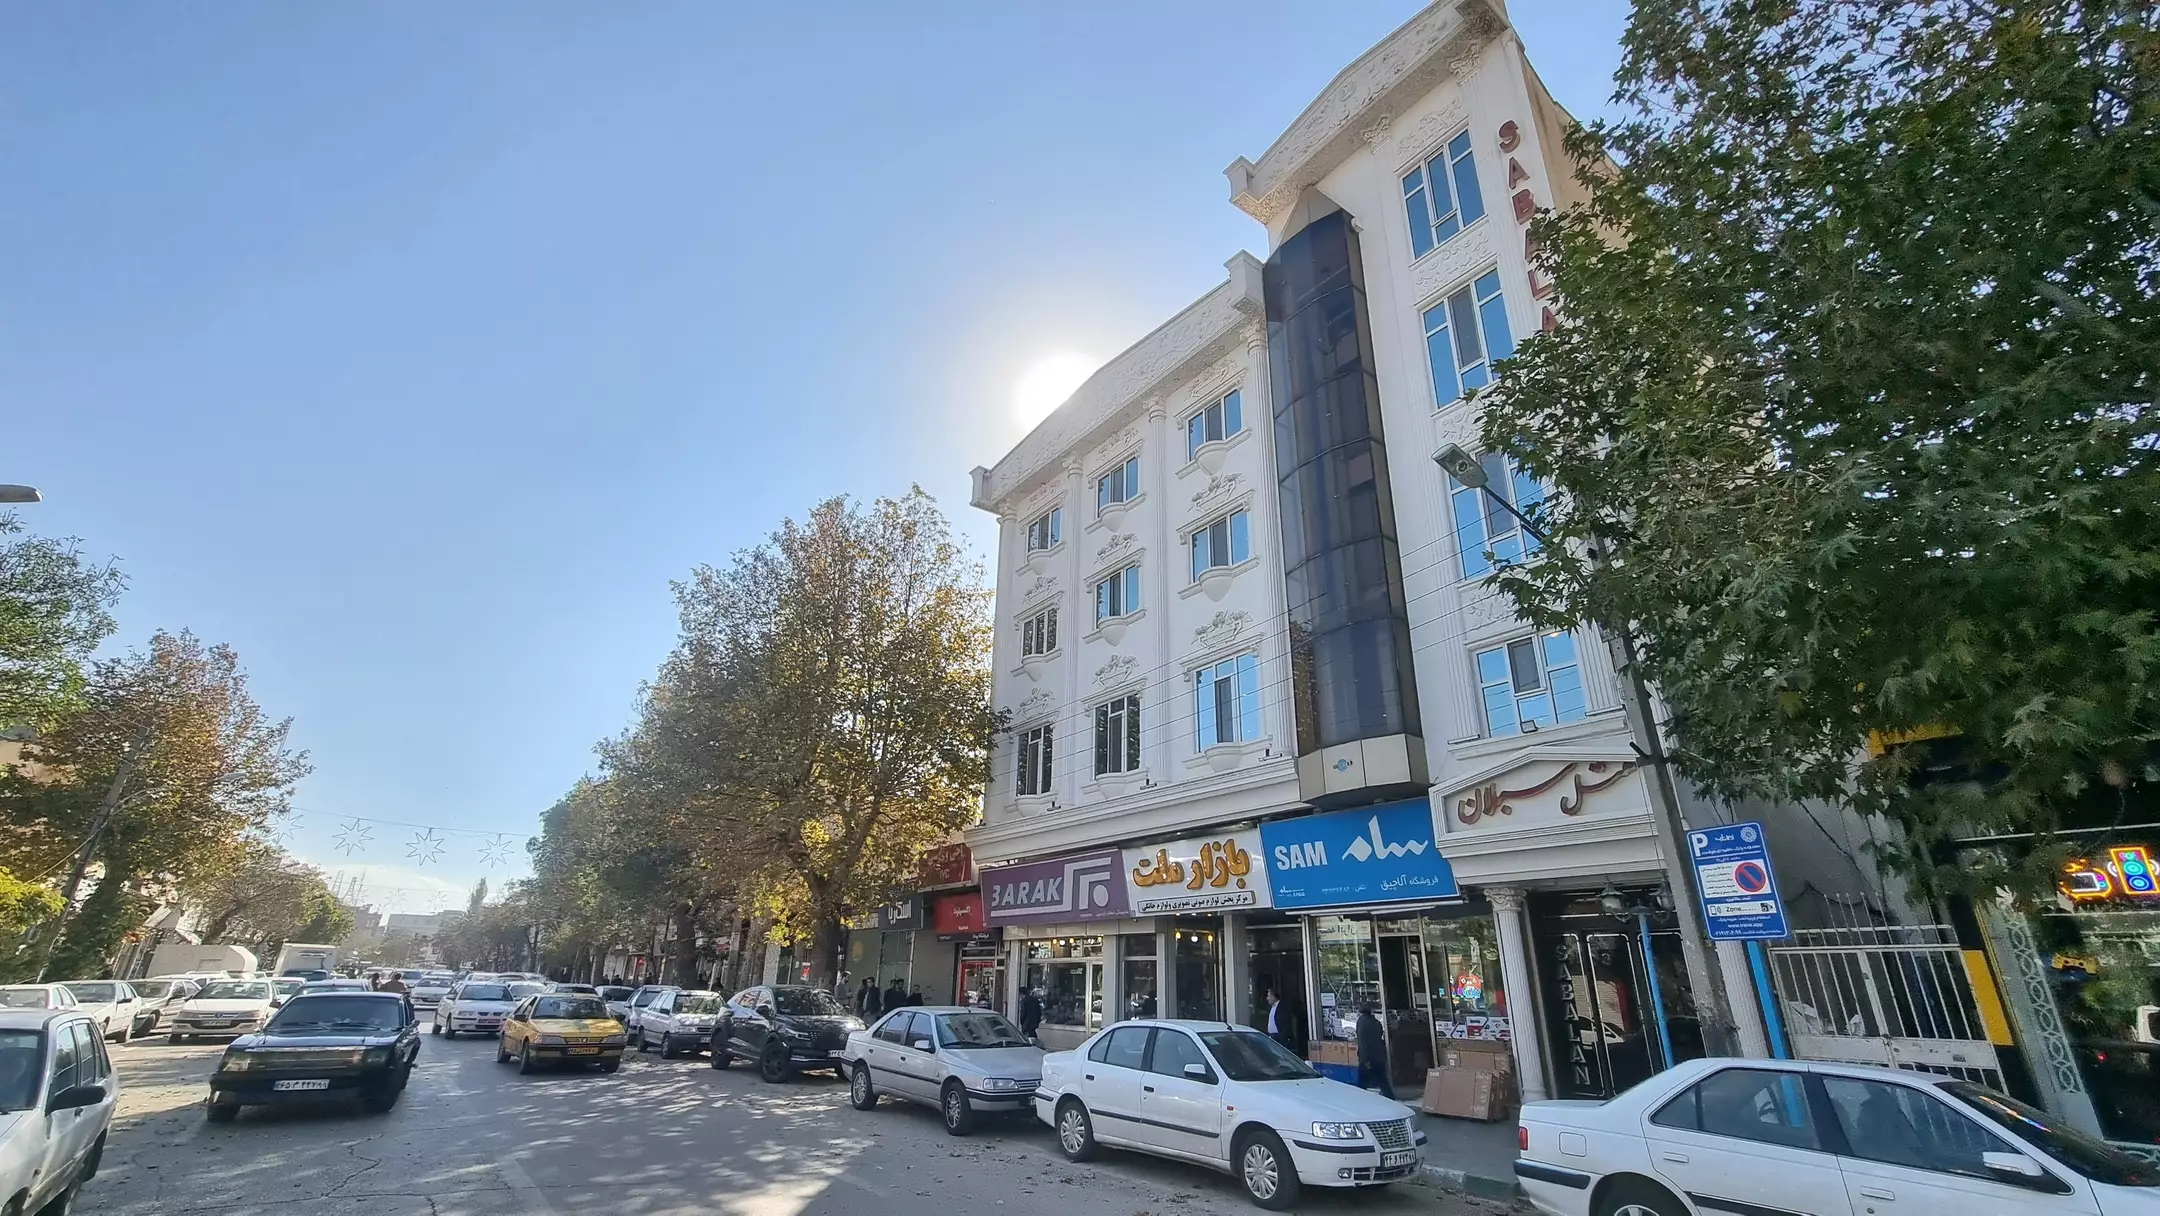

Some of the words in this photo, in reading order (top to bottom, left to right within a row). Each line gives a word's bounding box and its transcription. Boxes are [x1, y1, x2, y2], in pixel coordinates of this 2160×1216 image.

[1458, 762, 1577, 825] سبلان
[1341, 815, 1429, 862] سام
[1691, 833, 1708, 857] P
[1187, 839, 1250, 889] بازار
[1275, 841, 1328, 871] SAM
[1133, 849, 1184, 886] ملت
[1380, 873, 1407, 892] آلاچیق
[1409, 875, 1439, 886] فروشگاه
[1142, 903, 1156, 912] خانگی
[1172, 900, 1190, 909] تصویری
[1191, 898, 1205, 908] صوتی
[1206, 896, 1219, 906] لوازم
[1221, 896, 1234, 905] پخش
[1235, 894, 1248, 903] مرکز
[1556, 945, 1591, 1085] SABALAN
